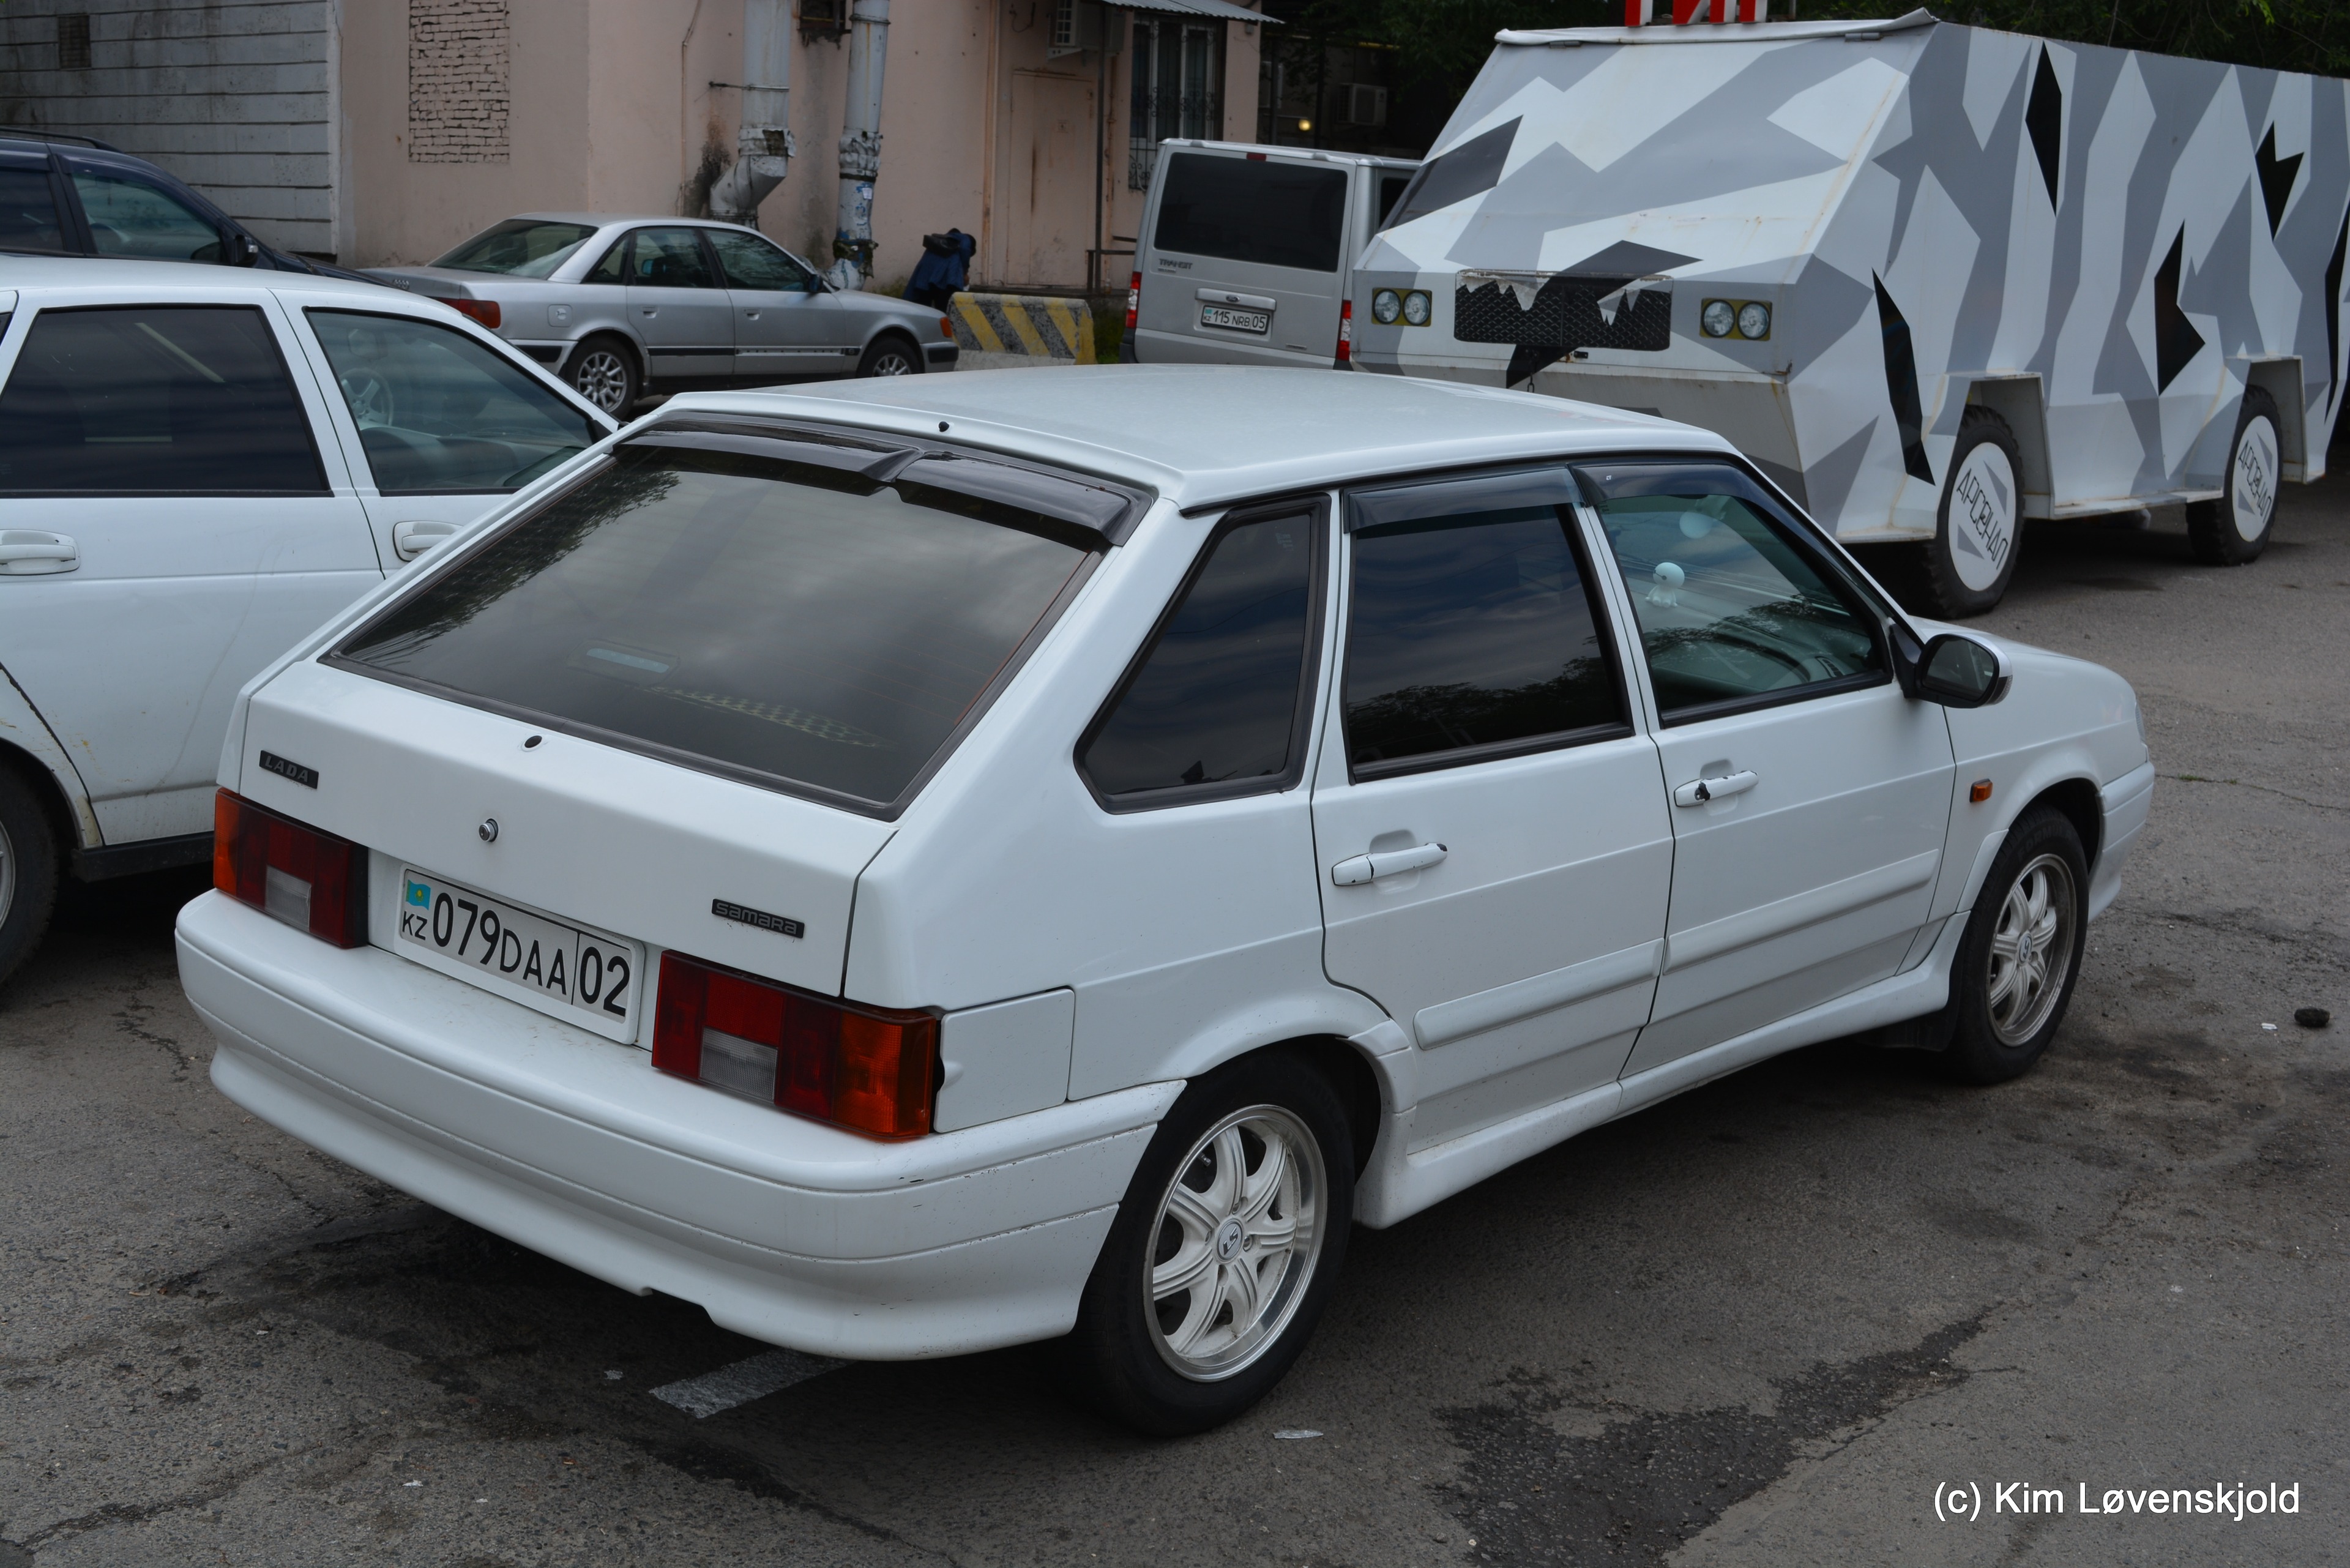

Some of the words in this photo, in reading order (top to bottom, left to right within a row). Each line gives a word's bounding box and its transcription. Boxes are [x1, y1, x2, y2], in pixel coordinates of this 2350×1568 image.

[1214, 310, 1230, 324] 115
[1232, 316, 1250, 327] NRB
[1252, 316, 1266, 329] 05
[265, 755, 308, 782] LADA
[402, 910, 427, 941] KZ
[580, 946, 630, 1017] 02
[1222, 1227, 1239, 1256] LS
